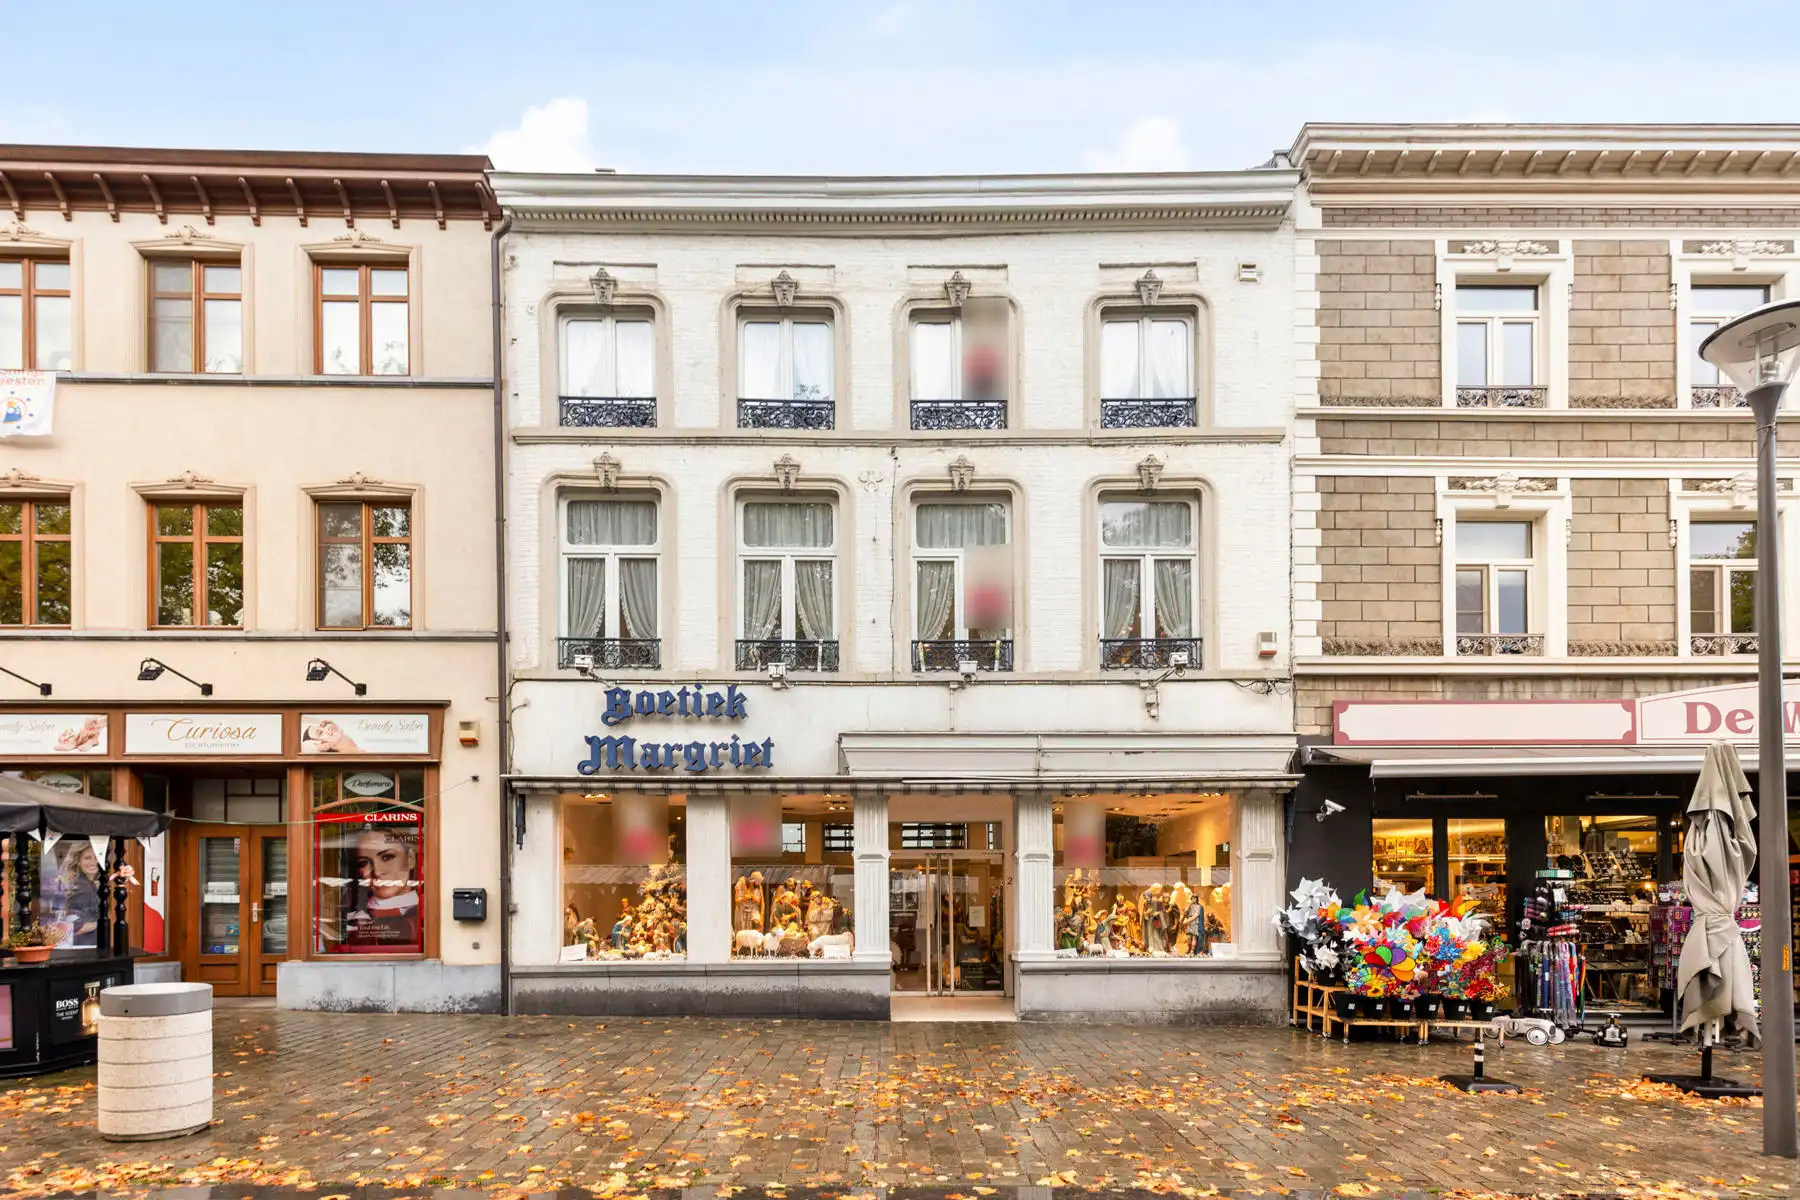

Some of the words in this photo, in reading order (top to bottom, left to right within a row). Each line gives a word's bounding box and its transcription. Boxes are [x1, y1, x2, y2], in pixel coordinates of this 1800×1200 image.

[601, 683, 748, 727] Boetiek
[1683, 701, 1755, 735] De
[151, 717, 257, 741] Curiosa
[577, 733, 775, 776] Margriet
[364, 813, 418, 822] CLARINS
[56, 998, 79, 1009] BOSS
